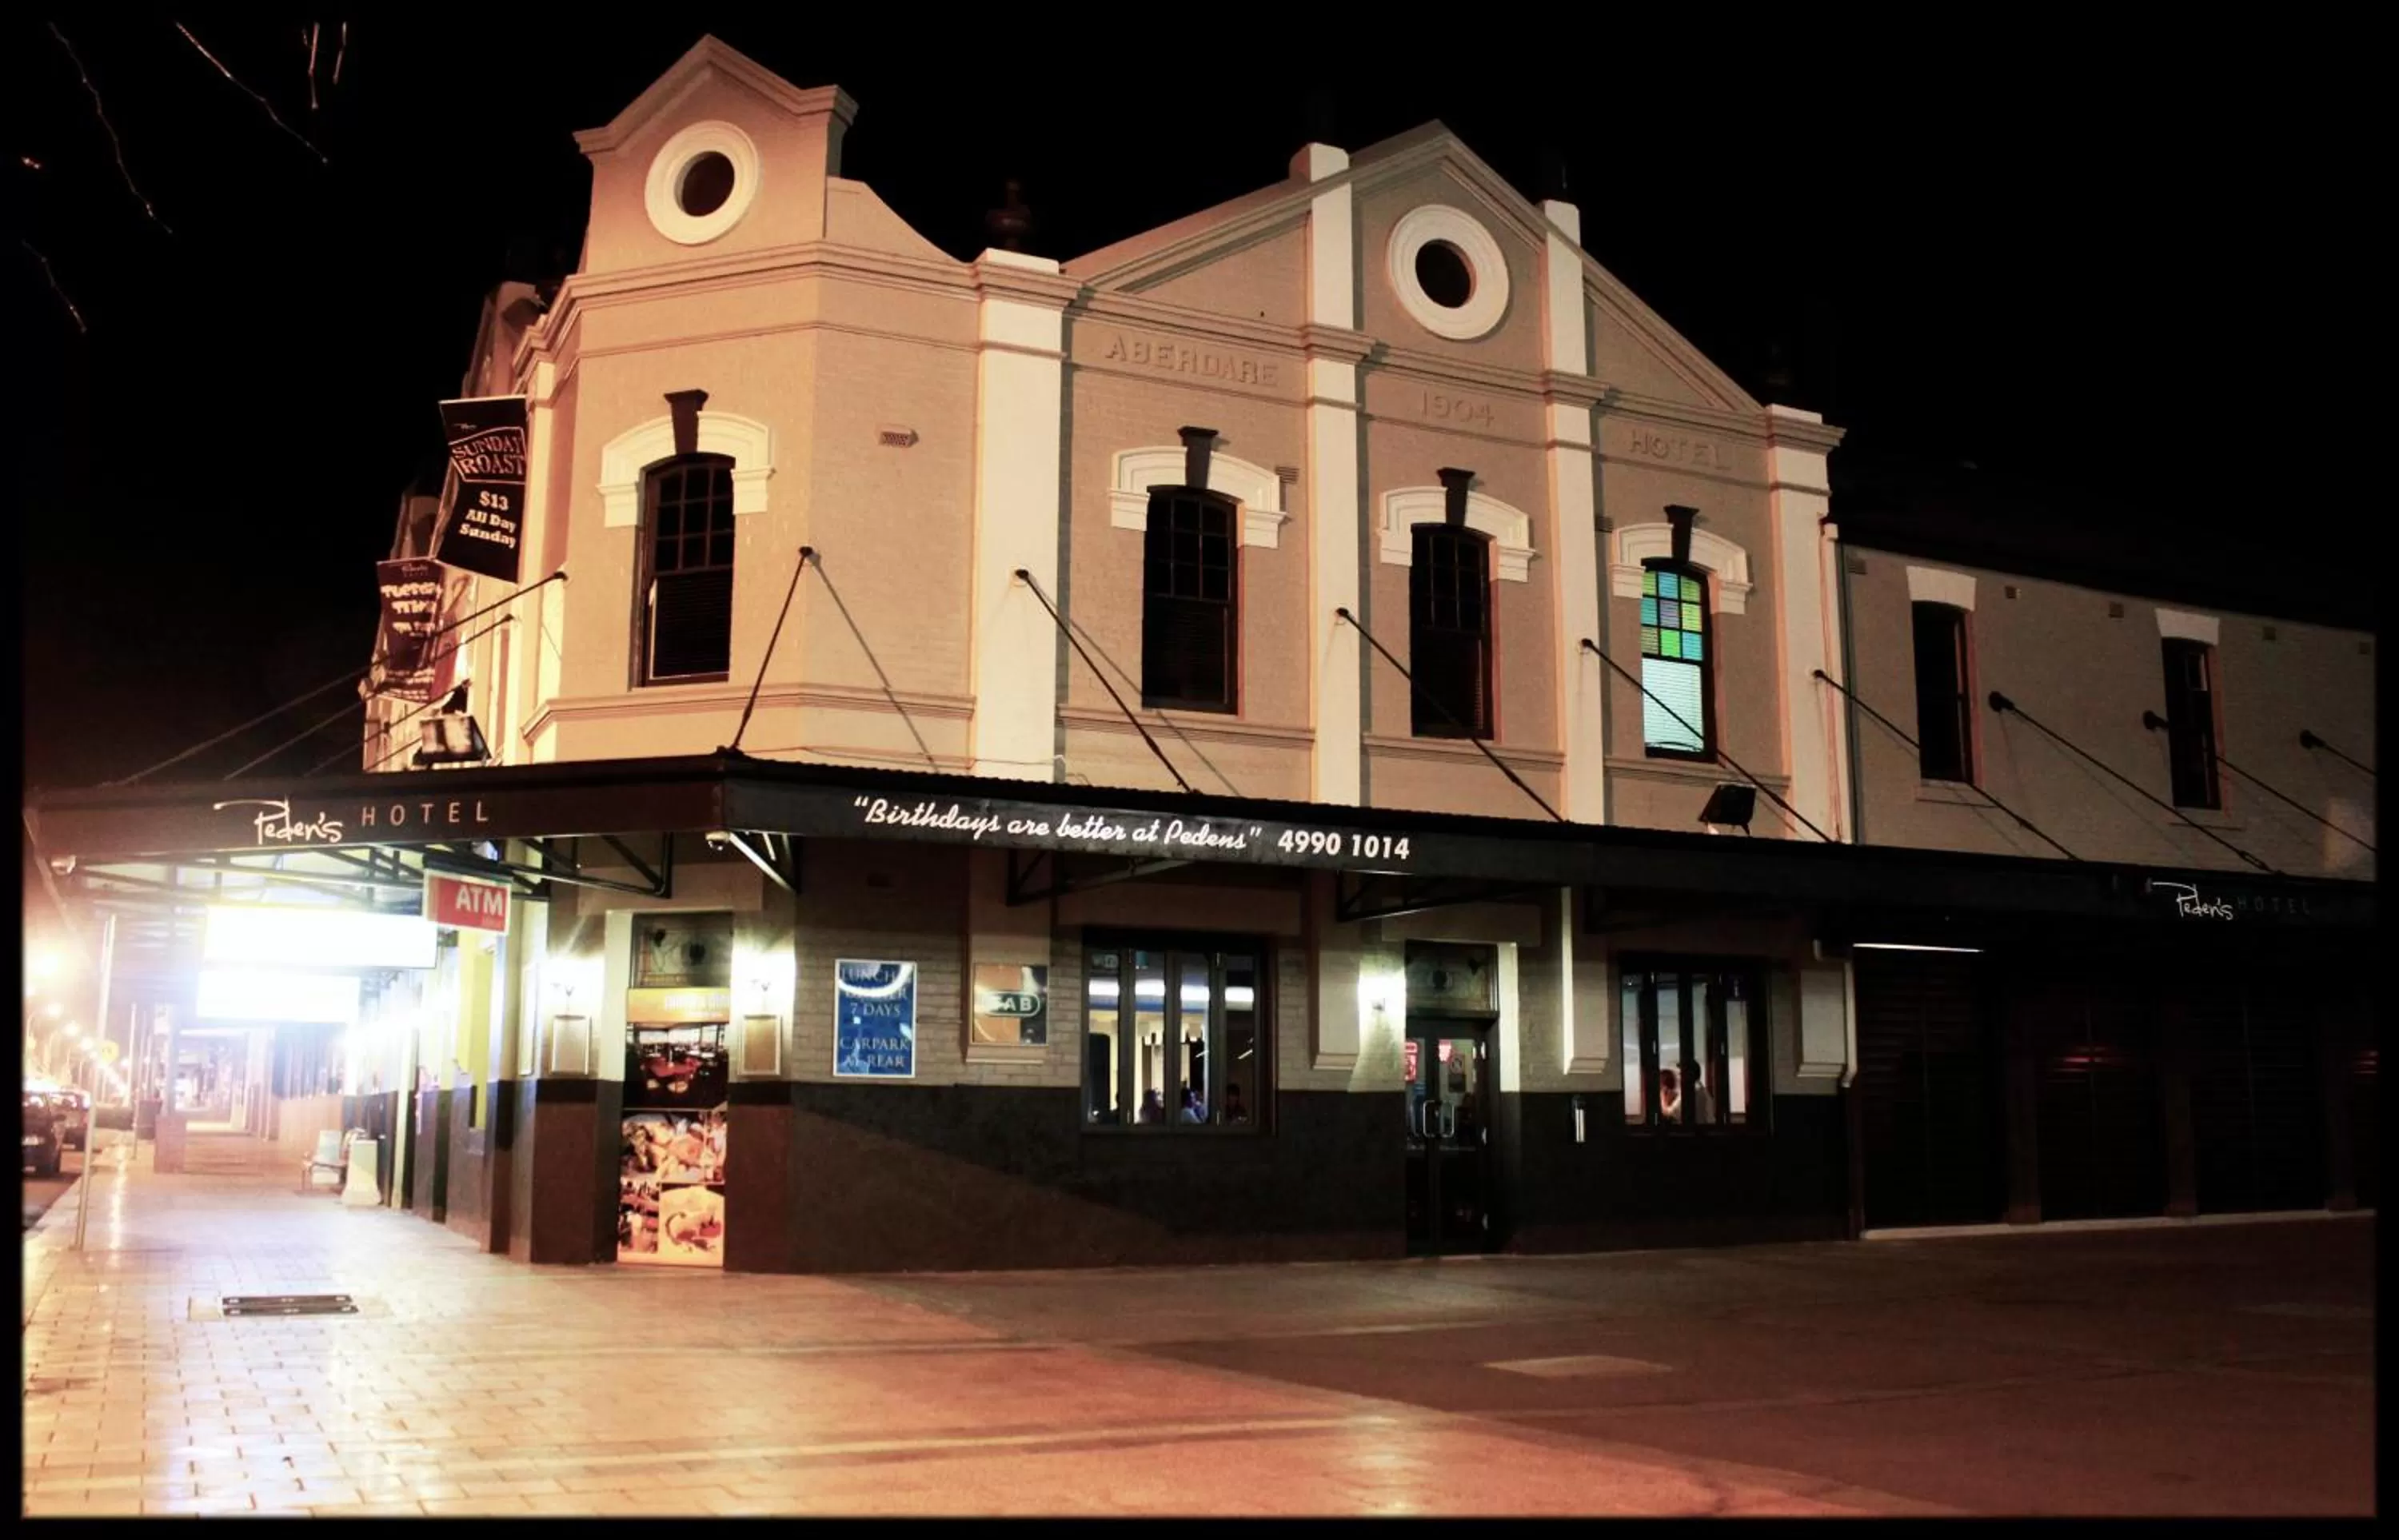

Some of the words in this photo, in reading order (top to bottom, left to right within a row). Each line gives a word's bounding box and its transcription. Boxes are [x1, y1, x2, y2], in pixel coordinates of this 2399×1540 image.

[1105, 333, 1279, 387] ABERDARE
[1423, 389, 1495, 429] 1904
[452, 435, 521, 458] SUNDAY
[1629, 428, 1732, 470] HOTEL
[459, 453, 525, 475] ROAST
[465, 509, 488, 525] All
[490, 513, 517, 533] Day
[459, 523, 517, 549] Sunday
[213, 795, 344, 844] Peden's
[361, 801, 489, 827] HOTEL
[1007, 819, 1050, 836] are
[1056, 812, 1127, 841] better
[1132, 819, 1160, 841] at
[1278, 829, 1342, 856] 4990
[1351, 834, 1411, 860] 1014
[455, 884, 504, 916] ATM
[2152, 883, 2234, 920] Peden's
[2237, 894, 2311, 915] HOTEL
[850, 1003, 859, 1015] 7
[863, 1003, 901, 1017] DAYS
[839, 1037, 909, 1051] CARPARK
[867, 1055, 906, 1068] REAR
